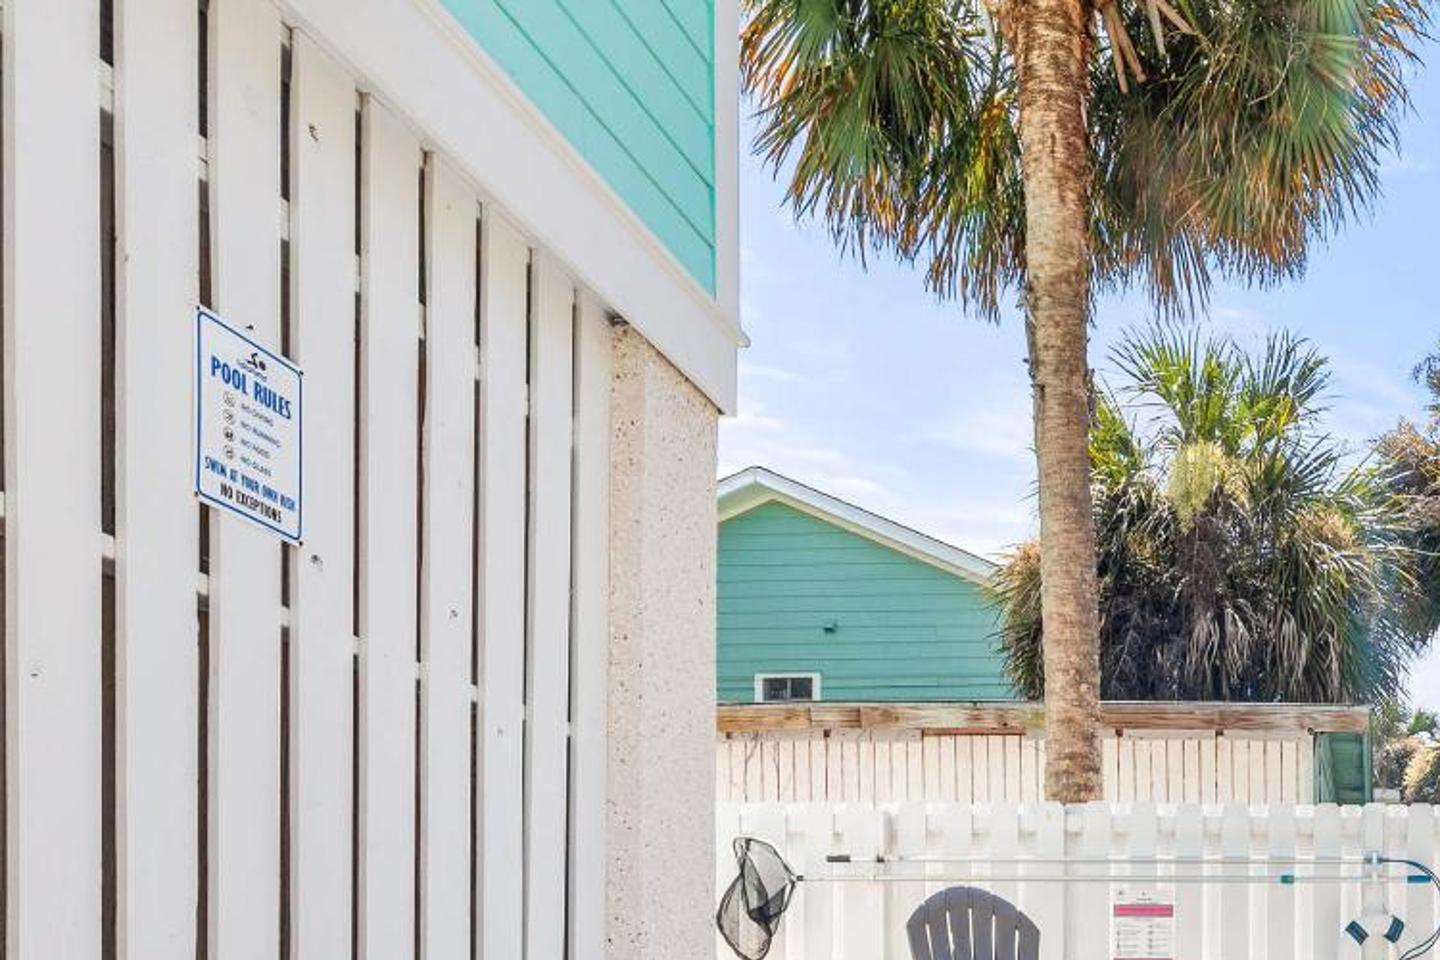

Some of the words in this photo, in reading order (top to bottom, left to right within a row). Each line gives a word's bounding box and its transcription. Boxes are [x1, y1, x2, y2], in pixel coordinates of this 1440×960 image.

[211, 355, 248, 396] POOL
[254, 381, 291, 419] RULES
[220, 482, 233, 499] NO
[236, 490, 281, 523] EXCEPTIONS
